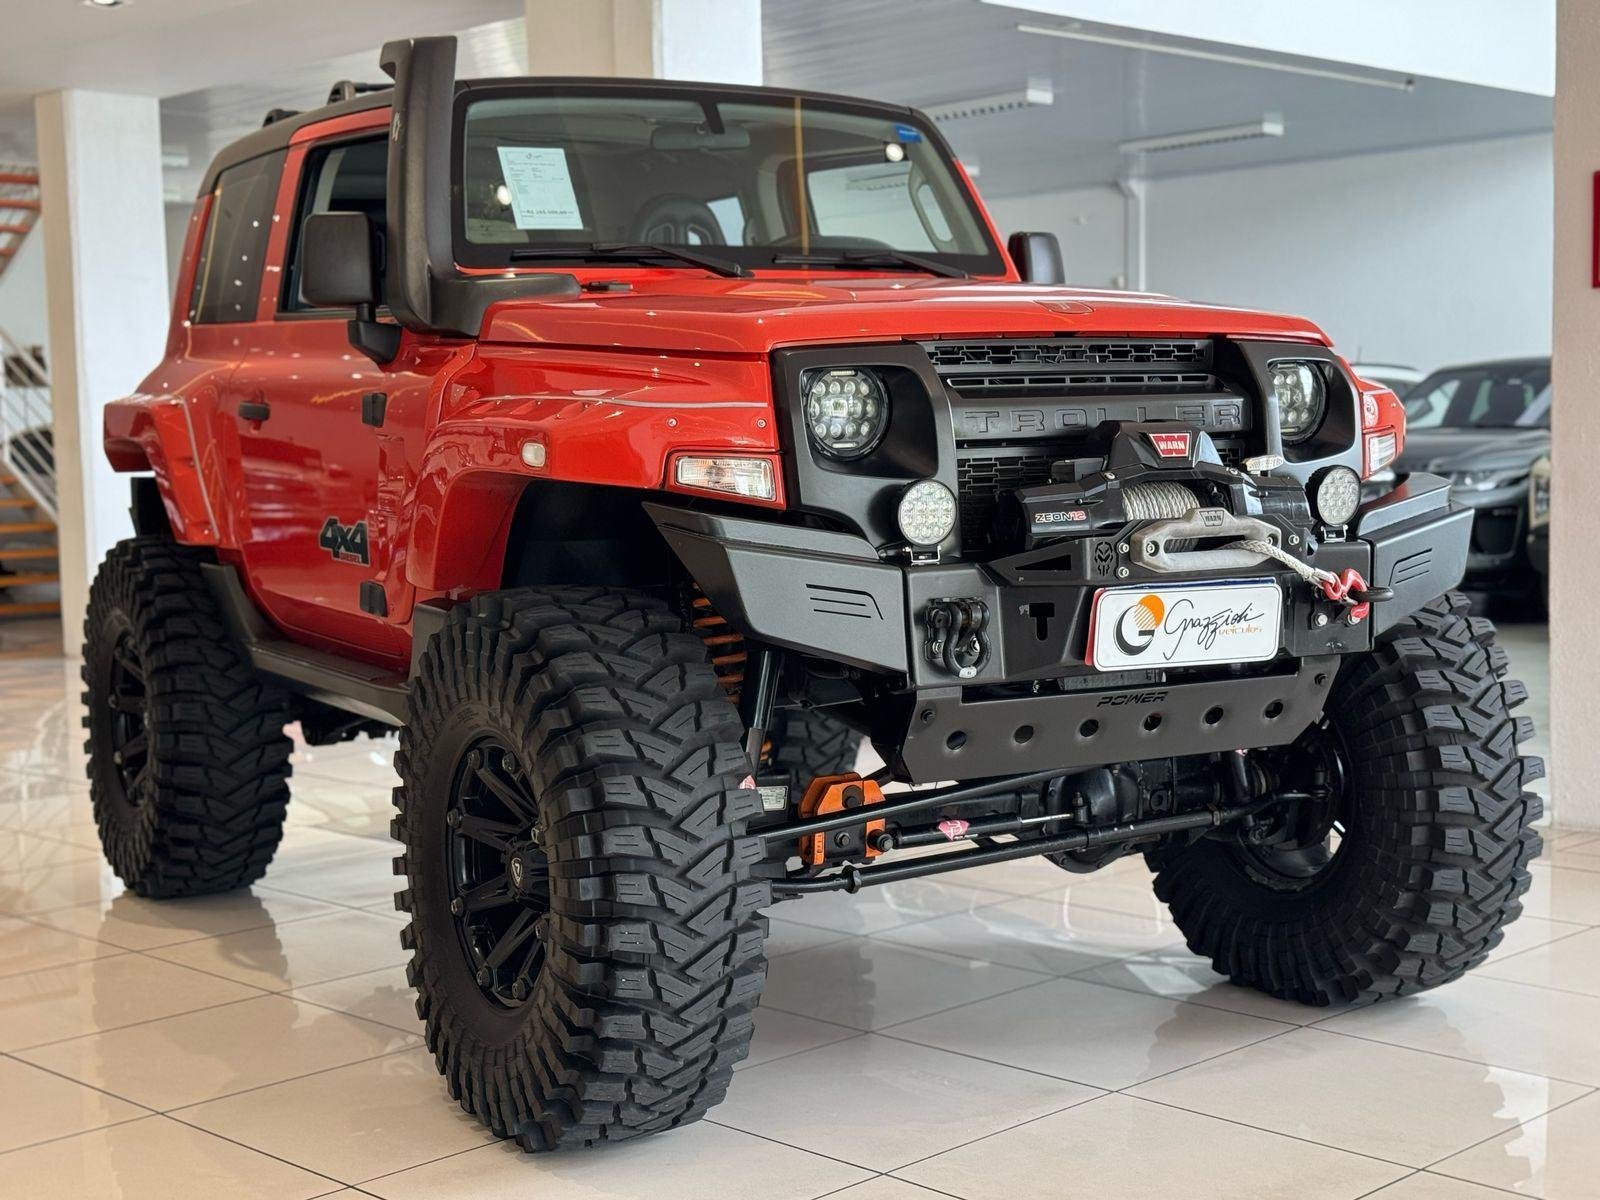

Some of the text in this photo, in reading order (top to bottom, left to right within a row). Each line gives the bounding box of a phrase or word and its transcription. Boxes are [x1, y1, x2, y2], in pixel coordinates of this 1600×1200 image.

[1158, 440, 1186, 450] WARN
[1163, 598, 1265, 661] Grazzioli
[1096, 691, 1169, 708] POWER
